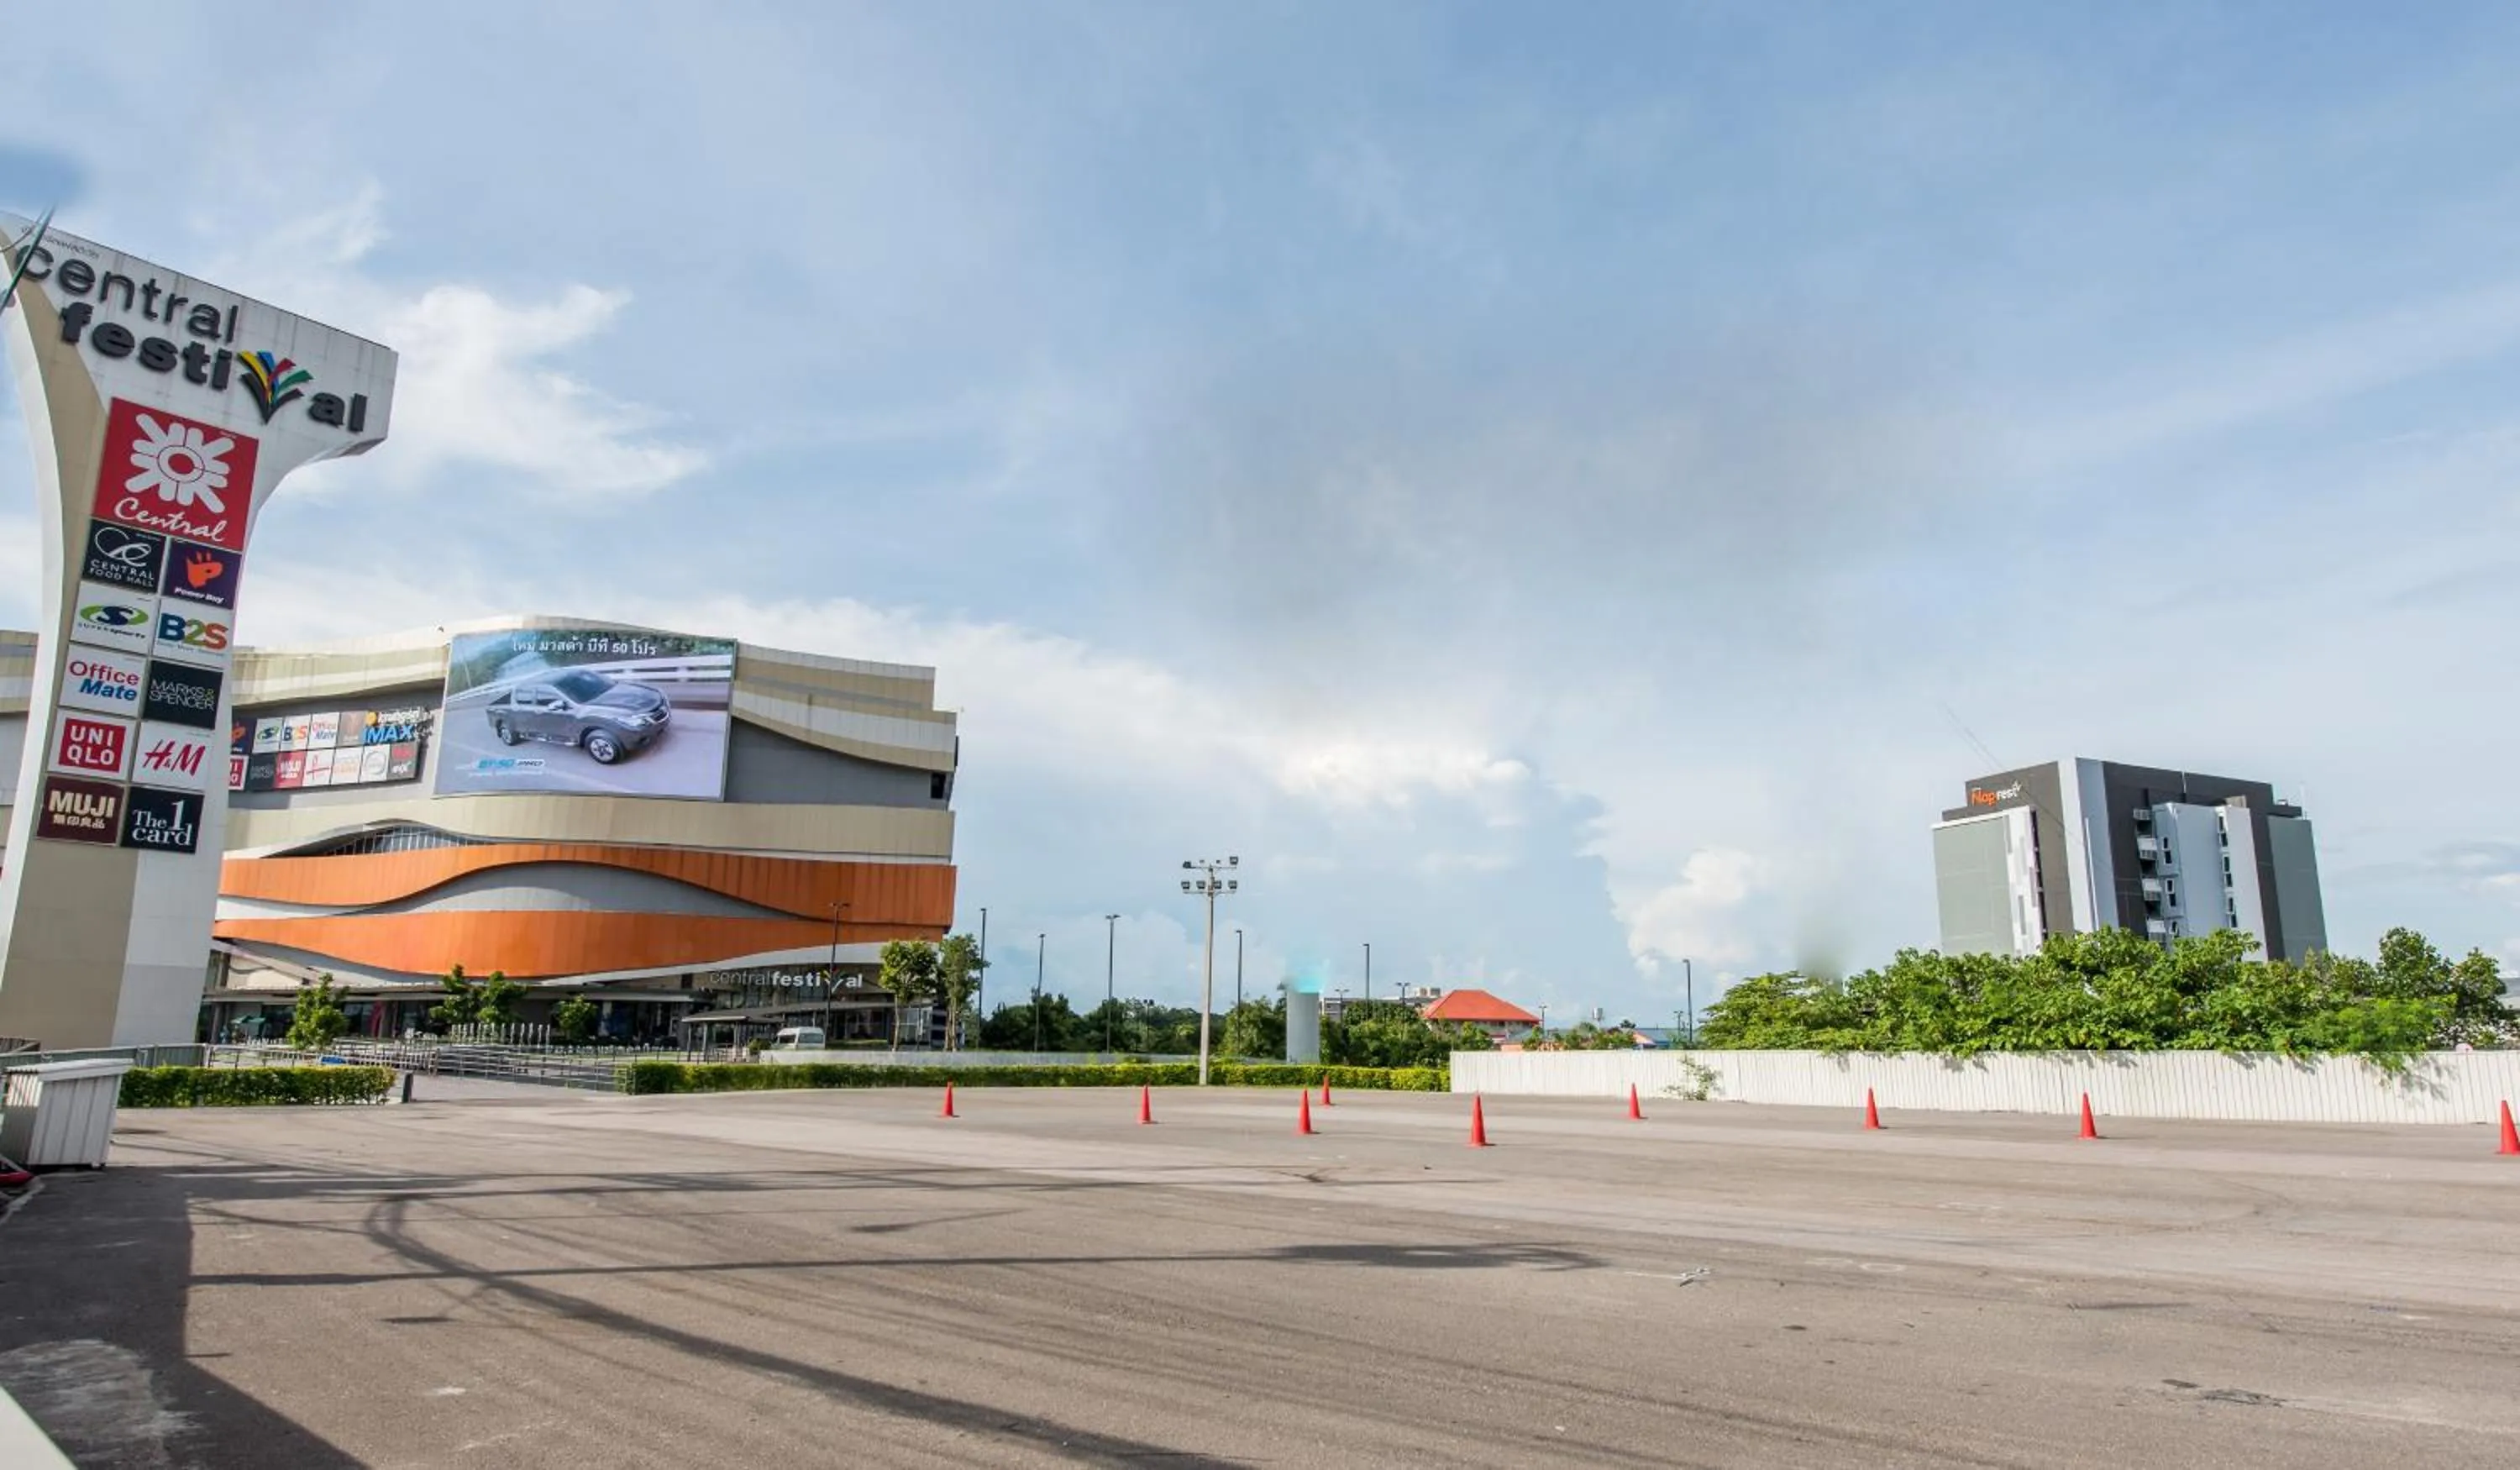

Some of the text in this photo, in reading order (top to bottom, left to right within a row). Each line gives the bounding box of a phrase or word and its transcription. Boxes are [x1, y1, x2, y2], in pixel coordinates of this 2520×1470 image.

[16, 244, 239, 343] central
[60, 302, 368, 433] festival
[114, 496, 228, 543] Central
[88, 568, 154, 588] FOOD HALL
[90, 559, 155, 581] CENTRAL
[174, 586, 205, 600] Power
[159, 612, 229, 650] B2S
[612, 642, 627, 654] 50
[69, 660, 140, 685] Office
[79, 678, 138, 701] Mate
[149, 690, 215, 711] SPENCER
[70, 724, 115, 745] UNI
[362, 725, 413, 744] IMAX
[66, 745, 116, 766] QLO
[143, 738, 207, 777] H&M
[49, 791, 117, 817] MUJI
[53, 816, 106, 830] 無印良品
[133, 801, 186, 831] The 1
[132, 822, 193, 847] card
